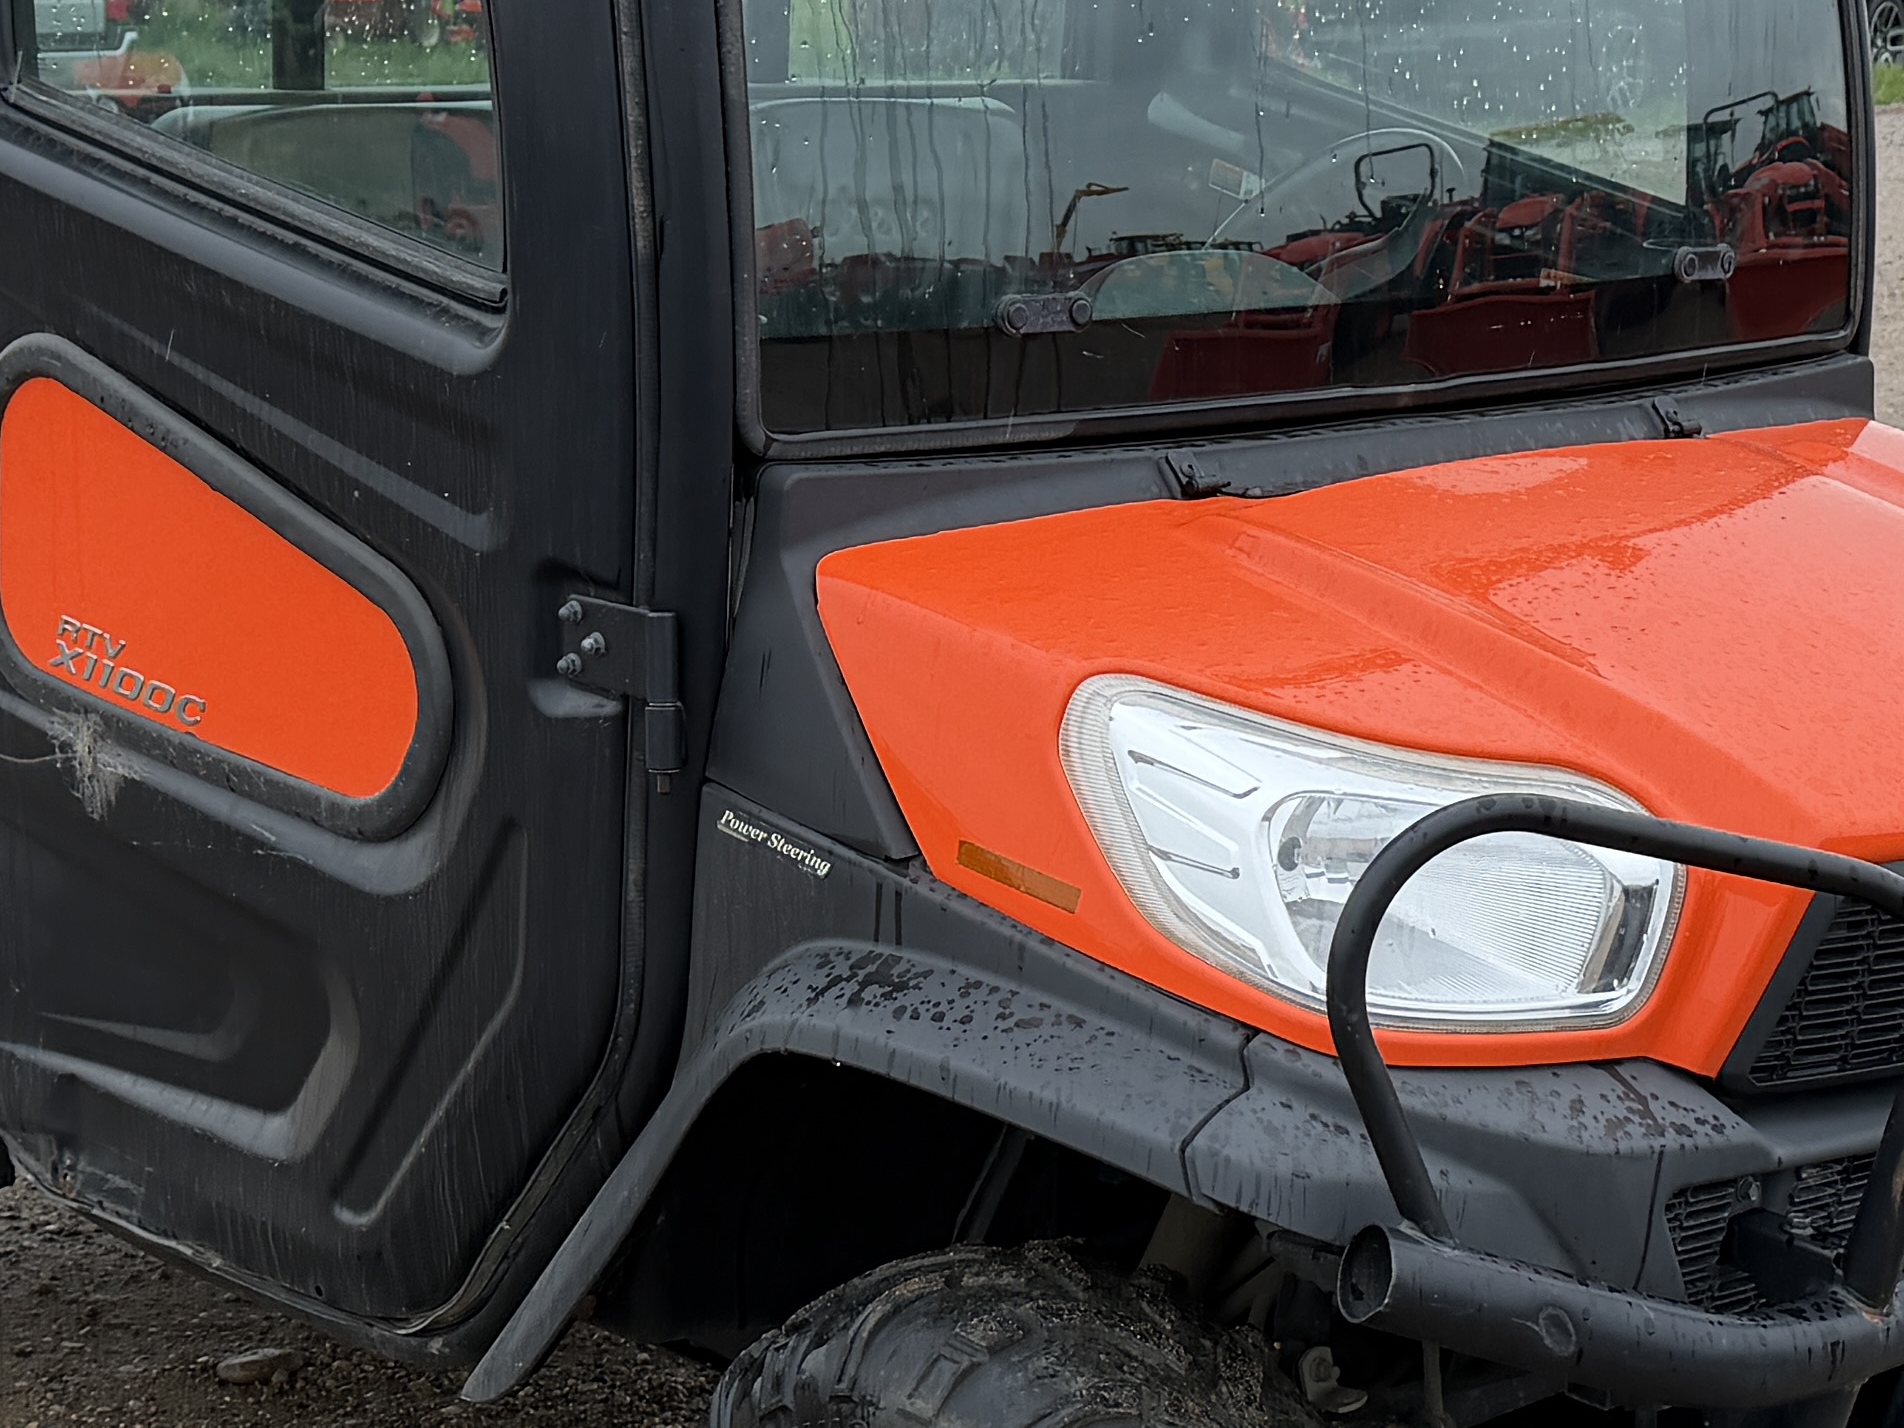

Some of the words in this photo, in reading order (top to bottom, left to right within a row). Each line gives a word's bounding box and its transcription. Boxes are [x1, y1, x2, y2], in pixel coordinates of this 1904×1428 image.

[58, 614, 126, 659] RTV
[49, 639, 206, 726] X1100C
[720, 810, 768, 842] Power
[767, 833, 831, 876] Steering
